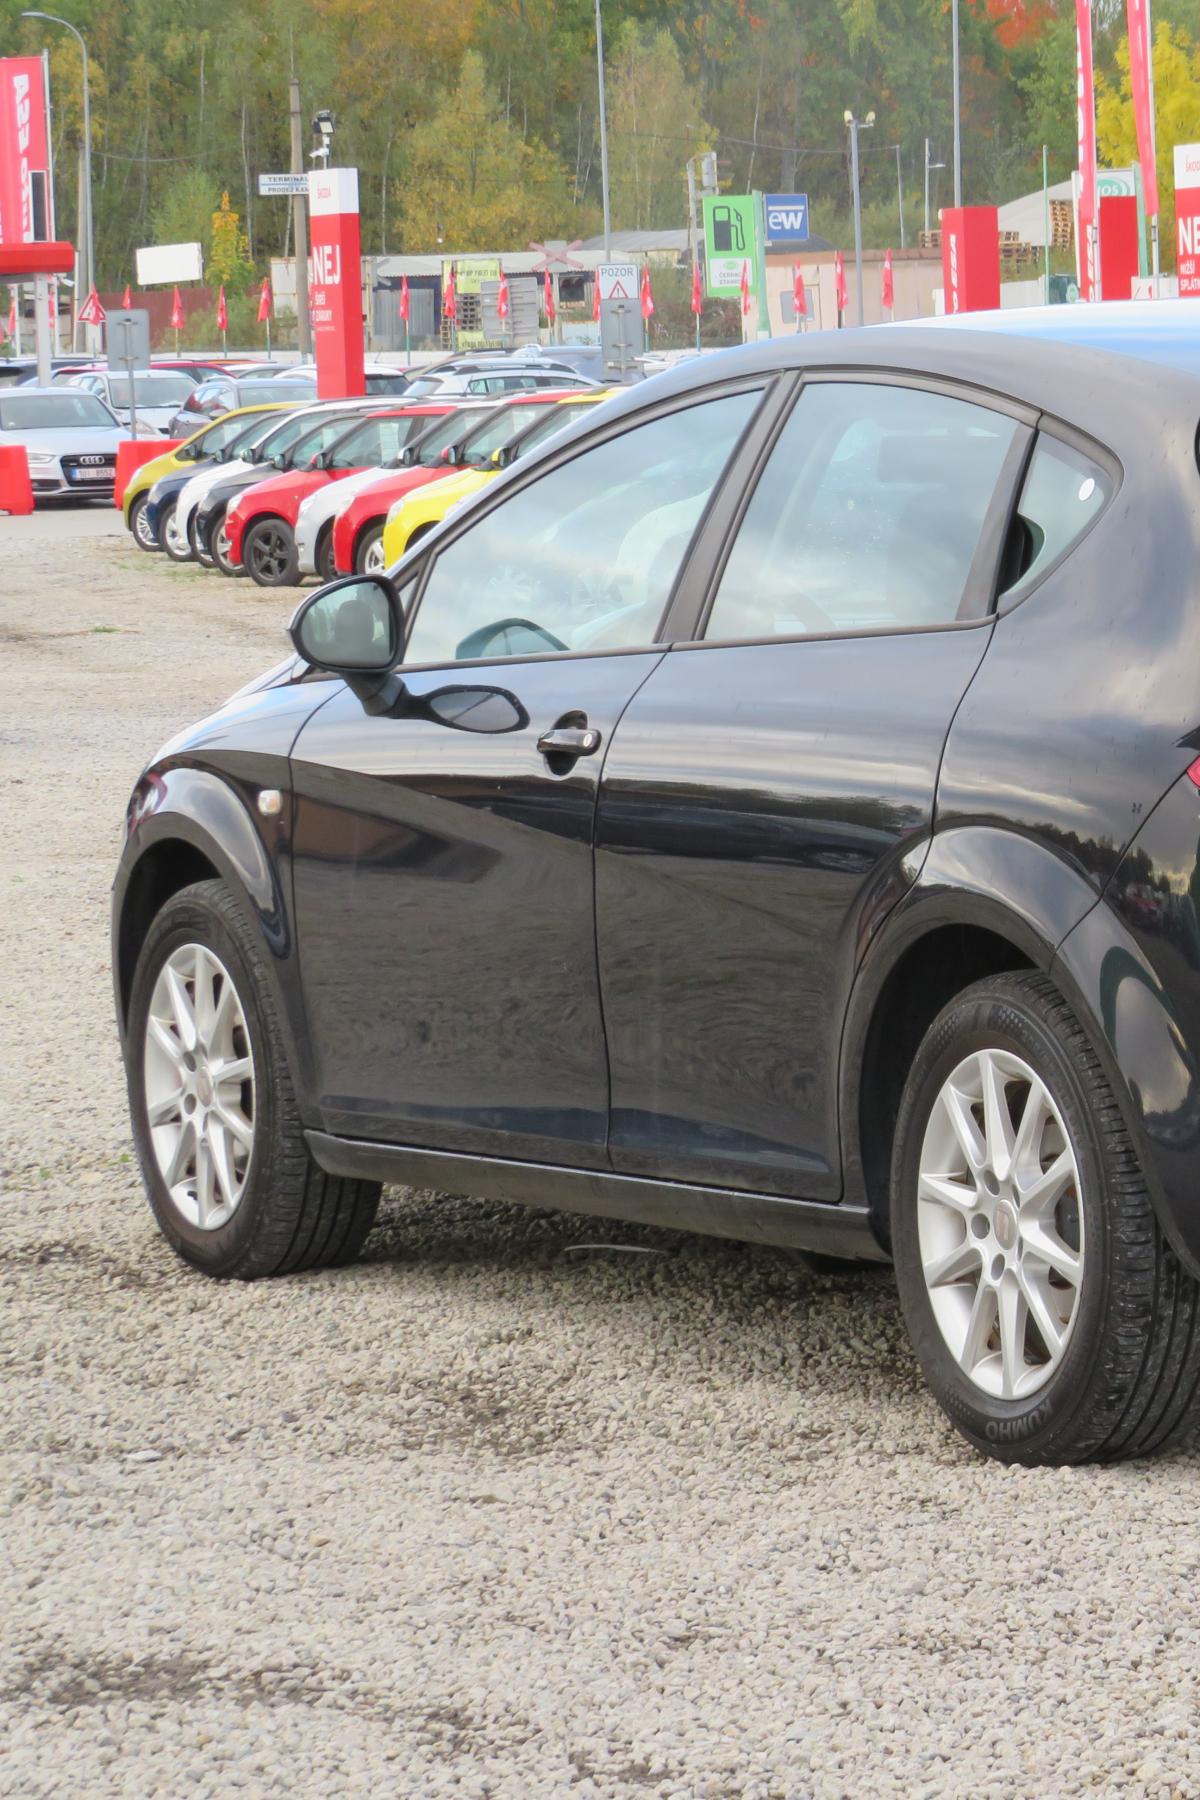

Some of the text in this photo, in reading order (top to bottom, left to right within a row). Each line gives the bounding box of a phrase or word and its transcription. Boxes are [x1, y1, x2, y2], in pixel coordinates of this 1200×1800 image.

[768, 211, 803, 230] ew
[313, 245, 340, 285] NEJ
[600, 267, 634, 278] POZOR
[984, 1400, 1054, 1442] KUMHO
